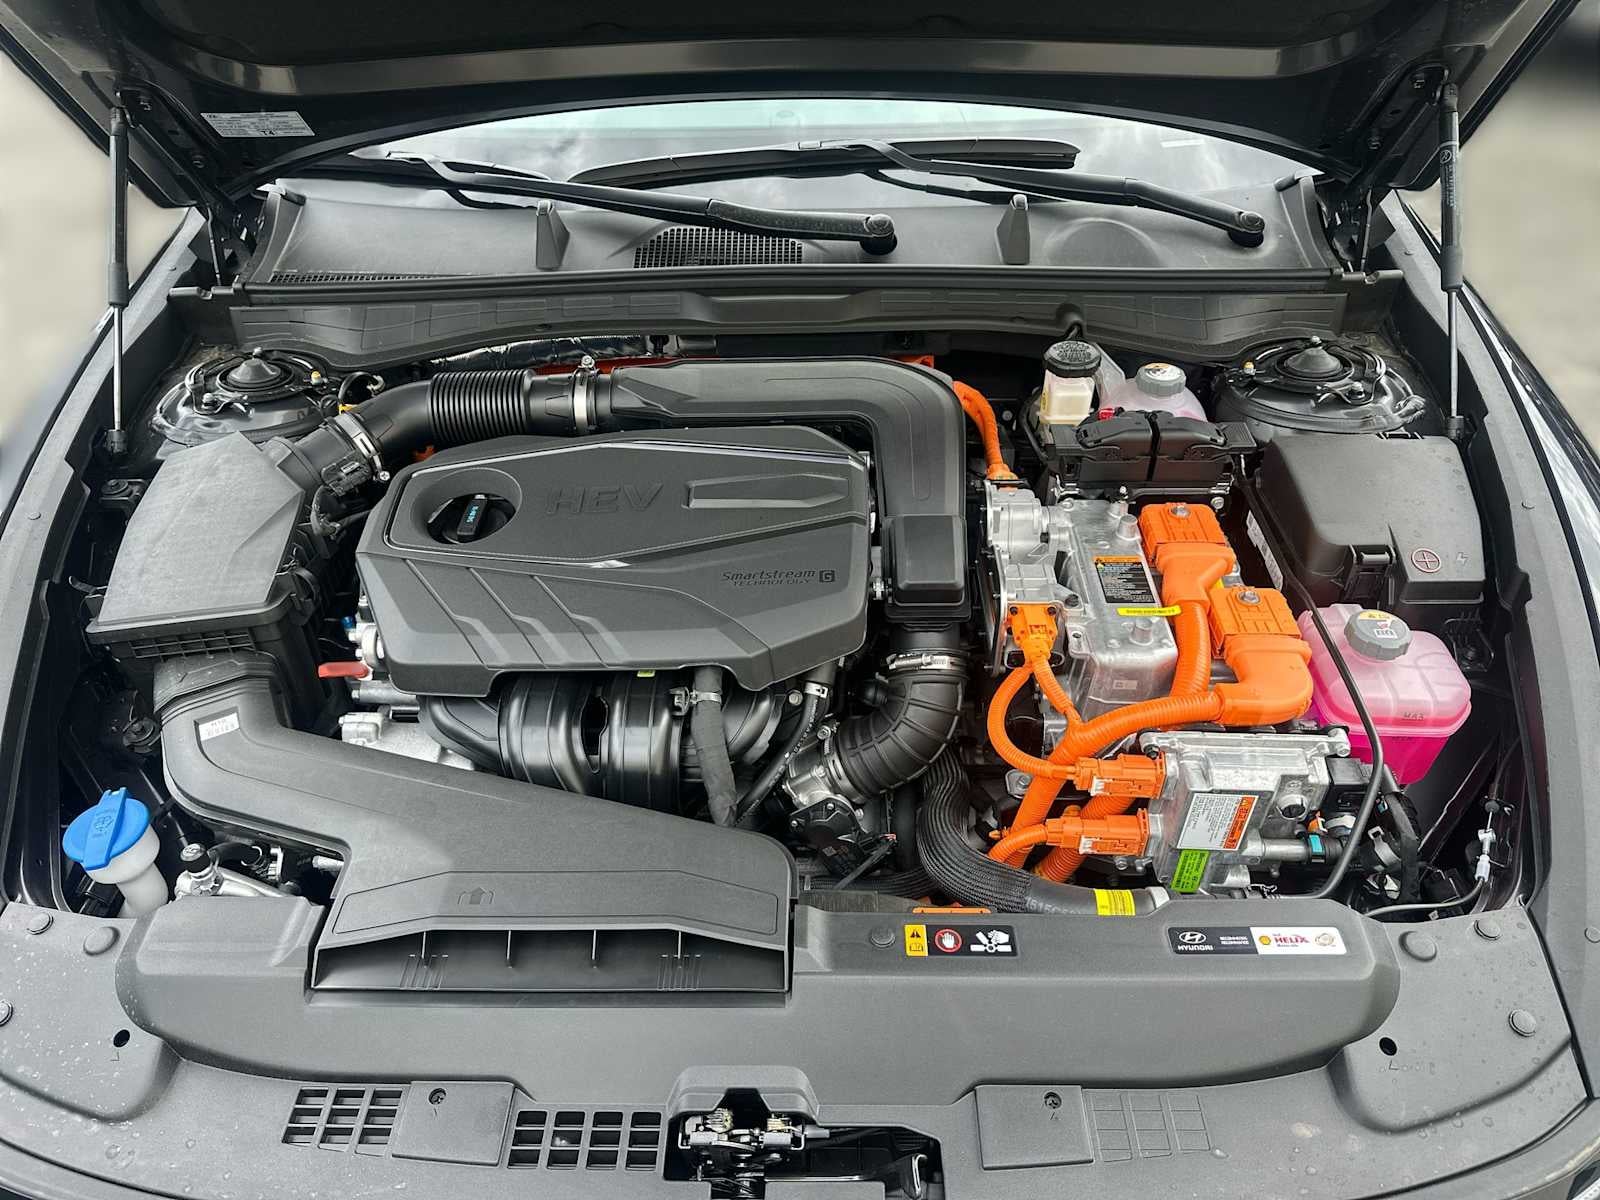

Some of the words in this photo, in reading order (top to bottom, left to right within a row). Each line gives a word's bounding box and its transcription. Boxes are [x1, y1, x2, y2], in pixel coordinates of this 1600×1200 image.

[545, 482, 664, 514] HEV
[722, 569, 816, 581] Smartstream
[820, 569, 835, 582] G
[1274, 935, 1309, 944] HELIX
